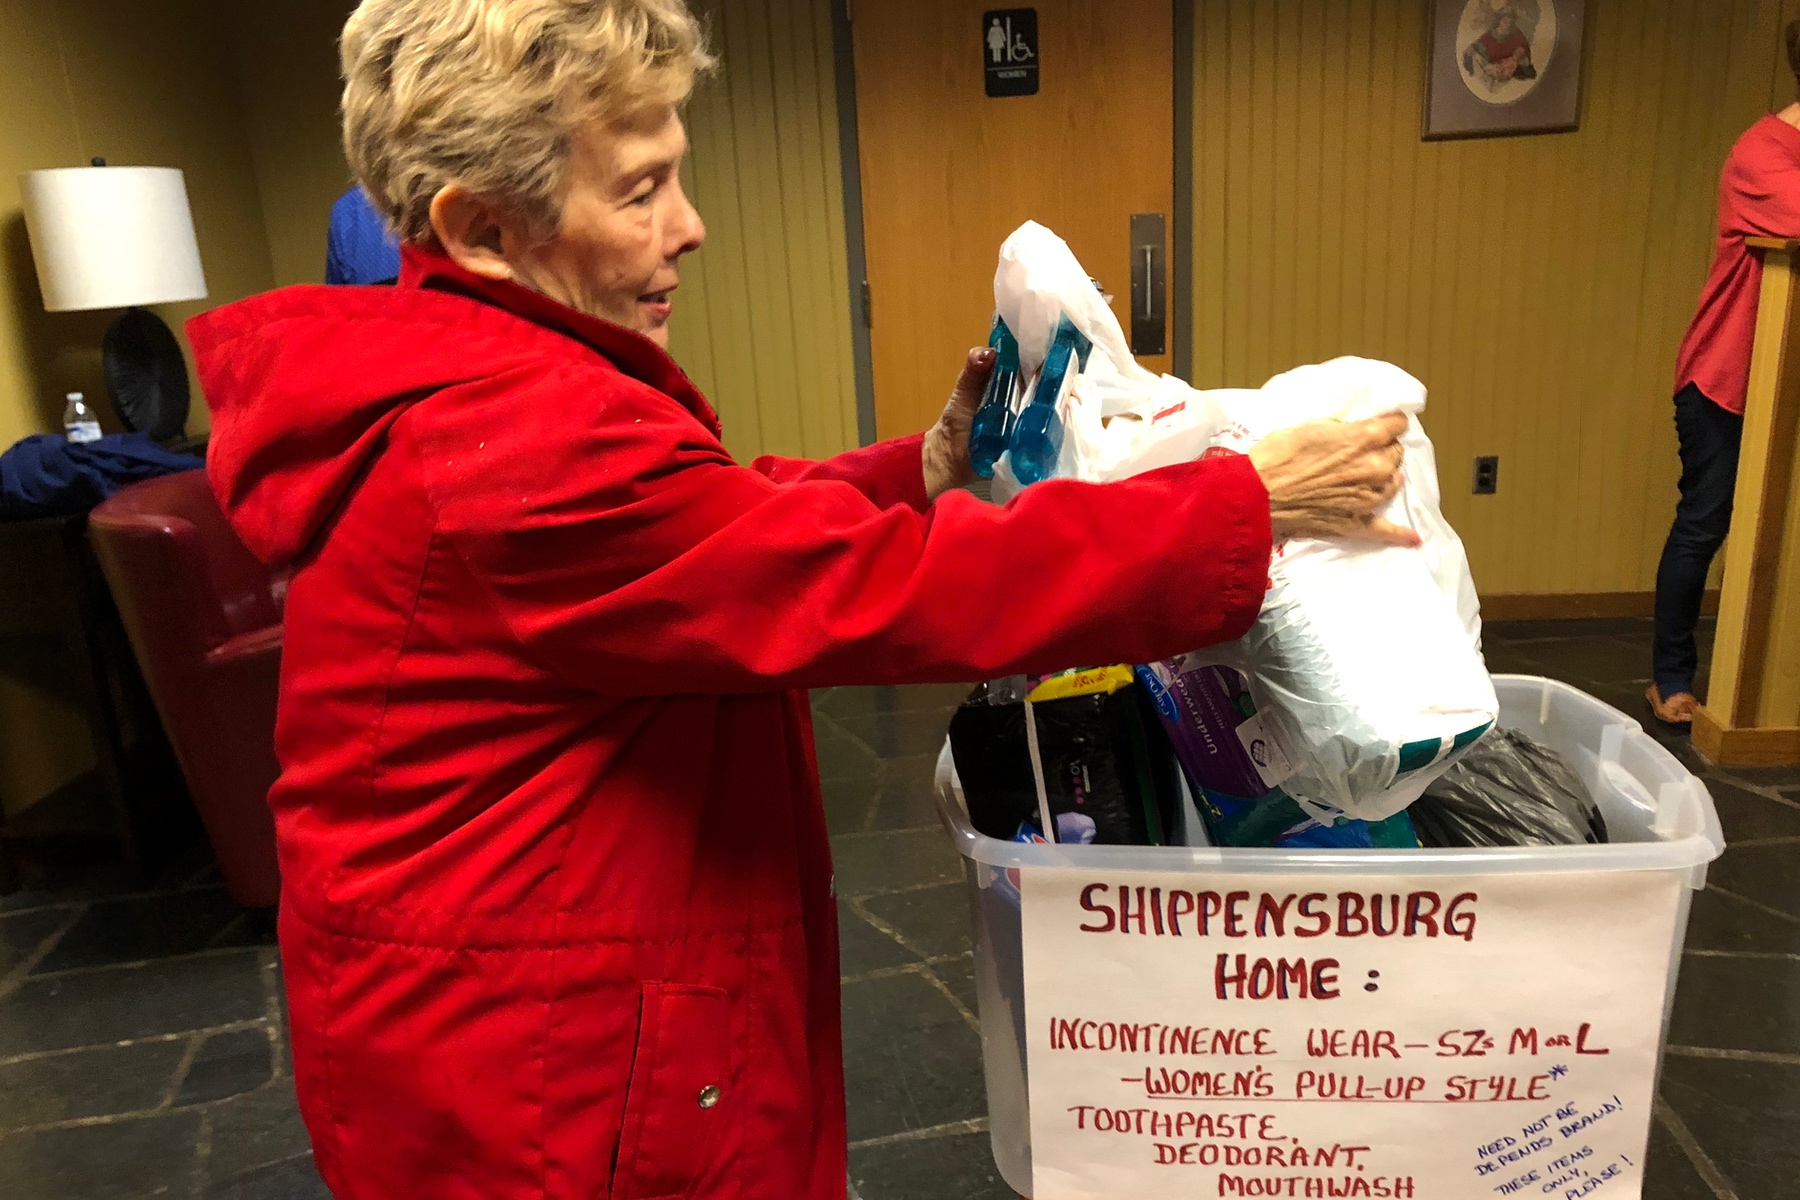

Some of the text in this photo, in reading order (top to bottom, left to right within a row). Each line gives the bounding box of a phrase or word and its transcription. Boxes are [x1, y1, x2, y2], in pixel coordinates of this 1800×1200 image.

[1079, 882, 1479, 942] SHIPPENSBURG
[1049, 1017, 1277, 1055] INCONTINENCE
[1295, 1070, 1425, 1100] PULL-UP
[1474, 1094, 1623, 1176] DEPENDS BRAND!
[1477, 1101, 1579, 1159] NEED NOT BE
[1218, 1173, 1415, 1199] MOUTHWASH
[1493, 1145, 1594, 1196] THESE ITEMS
